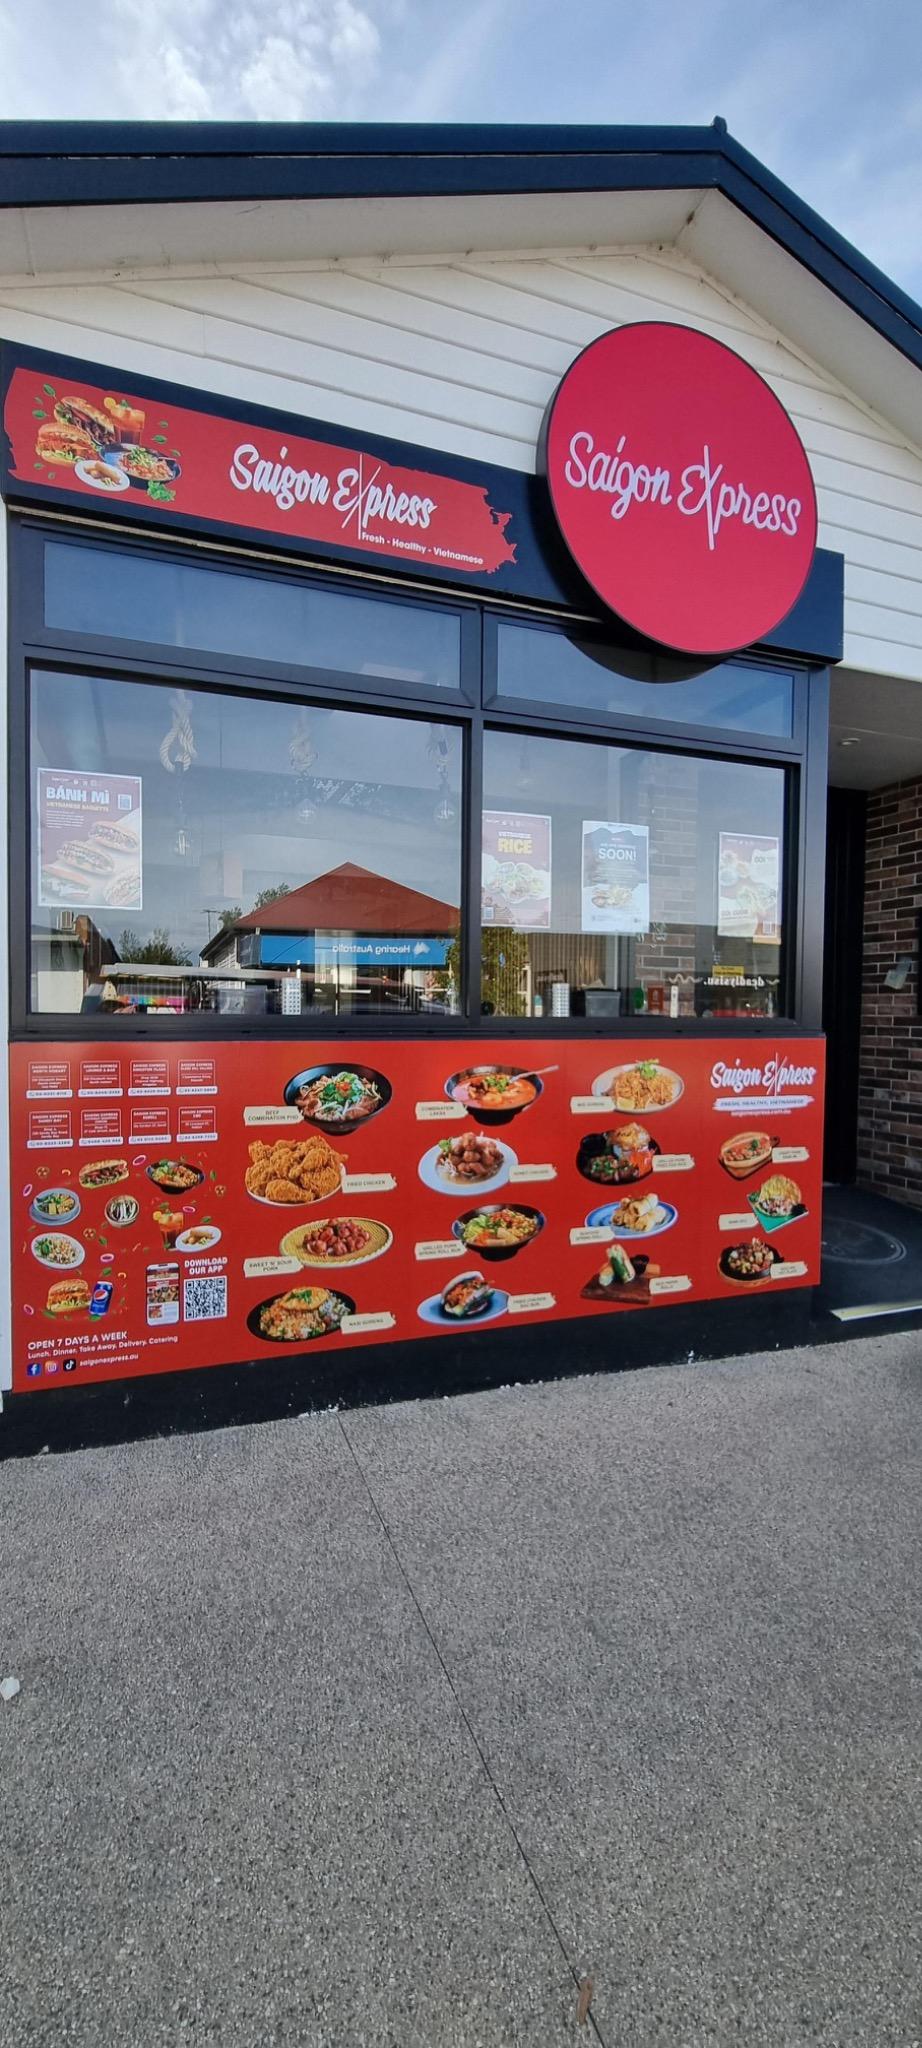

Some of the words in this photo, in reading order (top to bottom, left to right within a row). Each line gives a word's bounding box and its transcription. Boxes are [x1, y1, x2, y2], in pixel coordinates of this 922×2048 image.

[230, 444, 330, 510] Saigon
[565, 432, 672, 519] Saigon
[362, 532, 385, 545] Fresh
[392, 538, 426, 554] Healthy
[433, 546, 484, 565] Vietnamese
[46, 784, 87, 802] BÁNH
[498, 838, 533, 854] RICE
[598, 847, 637, 861] SOON!
[710, 1058, 761, 1093] Saigon
[185, 1256, 228, 1268] DOWNLOAD
[189, 1267, 206, 1275] OUR
[208, 1265, 223, 1273] APP
[28, 1339, 55, 1350] OPEN
[58, 1339, 62, 1347] 7
[65, 1336, 89, 1346] DAYS
[92, 1335, 99, 1343] A
[101, 1331, 127, 1341] WEEK
[149, 1336, 178, 1344] Catering
[80, 1354, 139, 1366] saigonexpress.au
